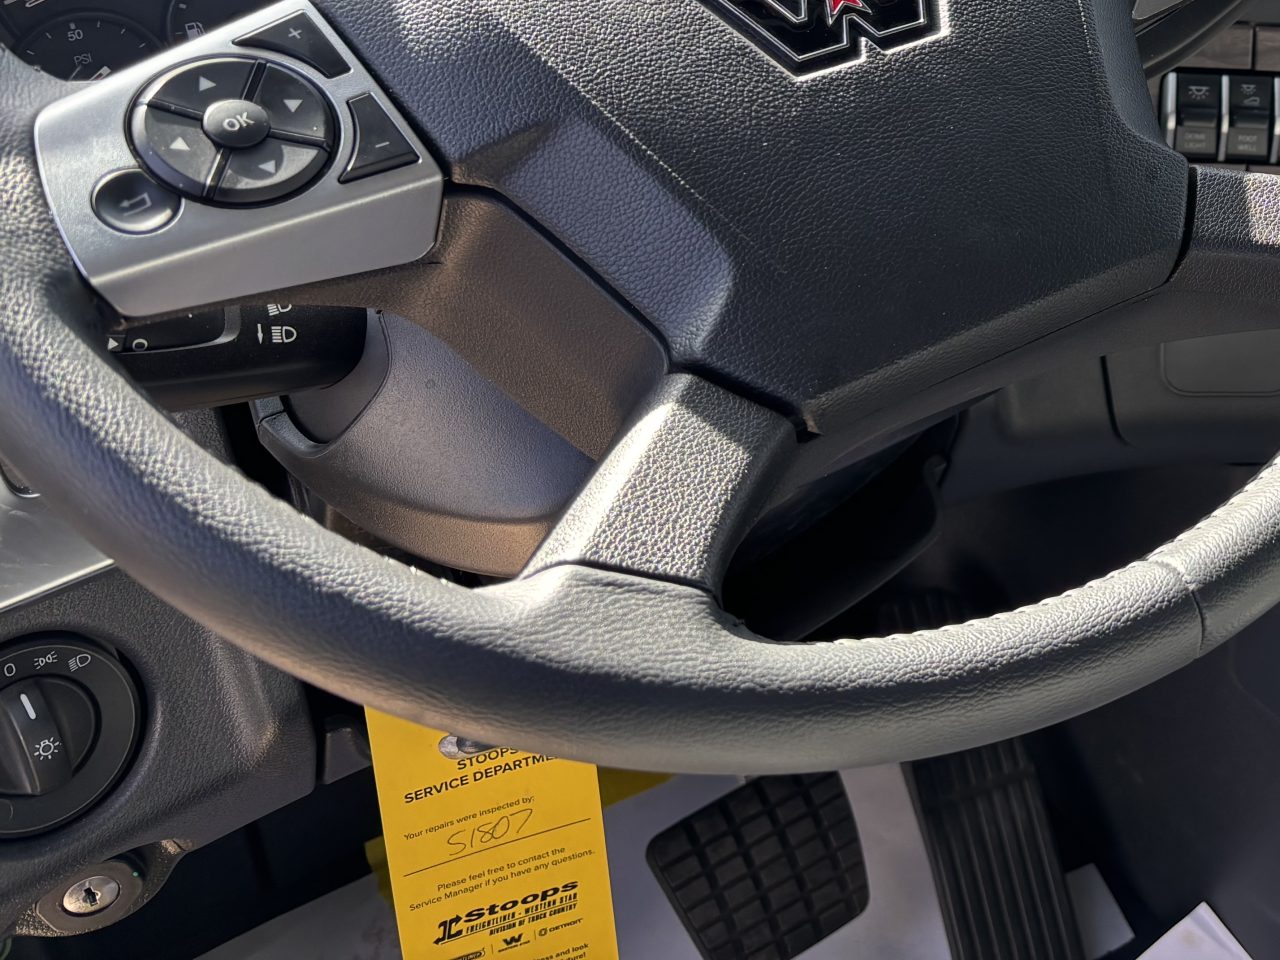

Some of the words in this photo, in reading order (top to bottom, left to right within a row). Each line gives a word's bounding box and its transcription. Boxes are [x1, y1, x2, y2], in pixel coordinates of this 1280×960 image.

[67, 29, 83, 41] 50
[73, 52, 92, 66] PSI
[222, 111, 254, 132] OK
[404, 774, 470, 804] SERVICE
[403, 829, 424, 841] Your
[425, 819, 455, 835] repairs
[456, 813, 478, 824] were
[479, 798, 521, 819] inspected
[521, 795, 535, 806] by:
[409, 895, 443, 911] Service
[444, 881, 484, 900] Manager
[492, 873, 509, 886] you
[510, 867, 532, 879] have
[533, 861, 550, 873] any
[551, 848, 596, 867] questions.
[437, 876, 467, 892] Please
[468, 870, 486, 882] feel
[486, 864, 505, 877] free
[506, 860, 516, 870] to
[517, 851, 550, 867] contact
[551, 846, 566, 856] the
[463, 880, 579, 923] Stoops
[466, 911, 516, 934] FREIGHTLINER
[524, 898, 557, 915] WESTERN
[559, 892, 578, 904] STAR
[548, 917, 584, 933] DETROIT
[555, 948, 571, 958] and
[572, 943, 589, 953] look
